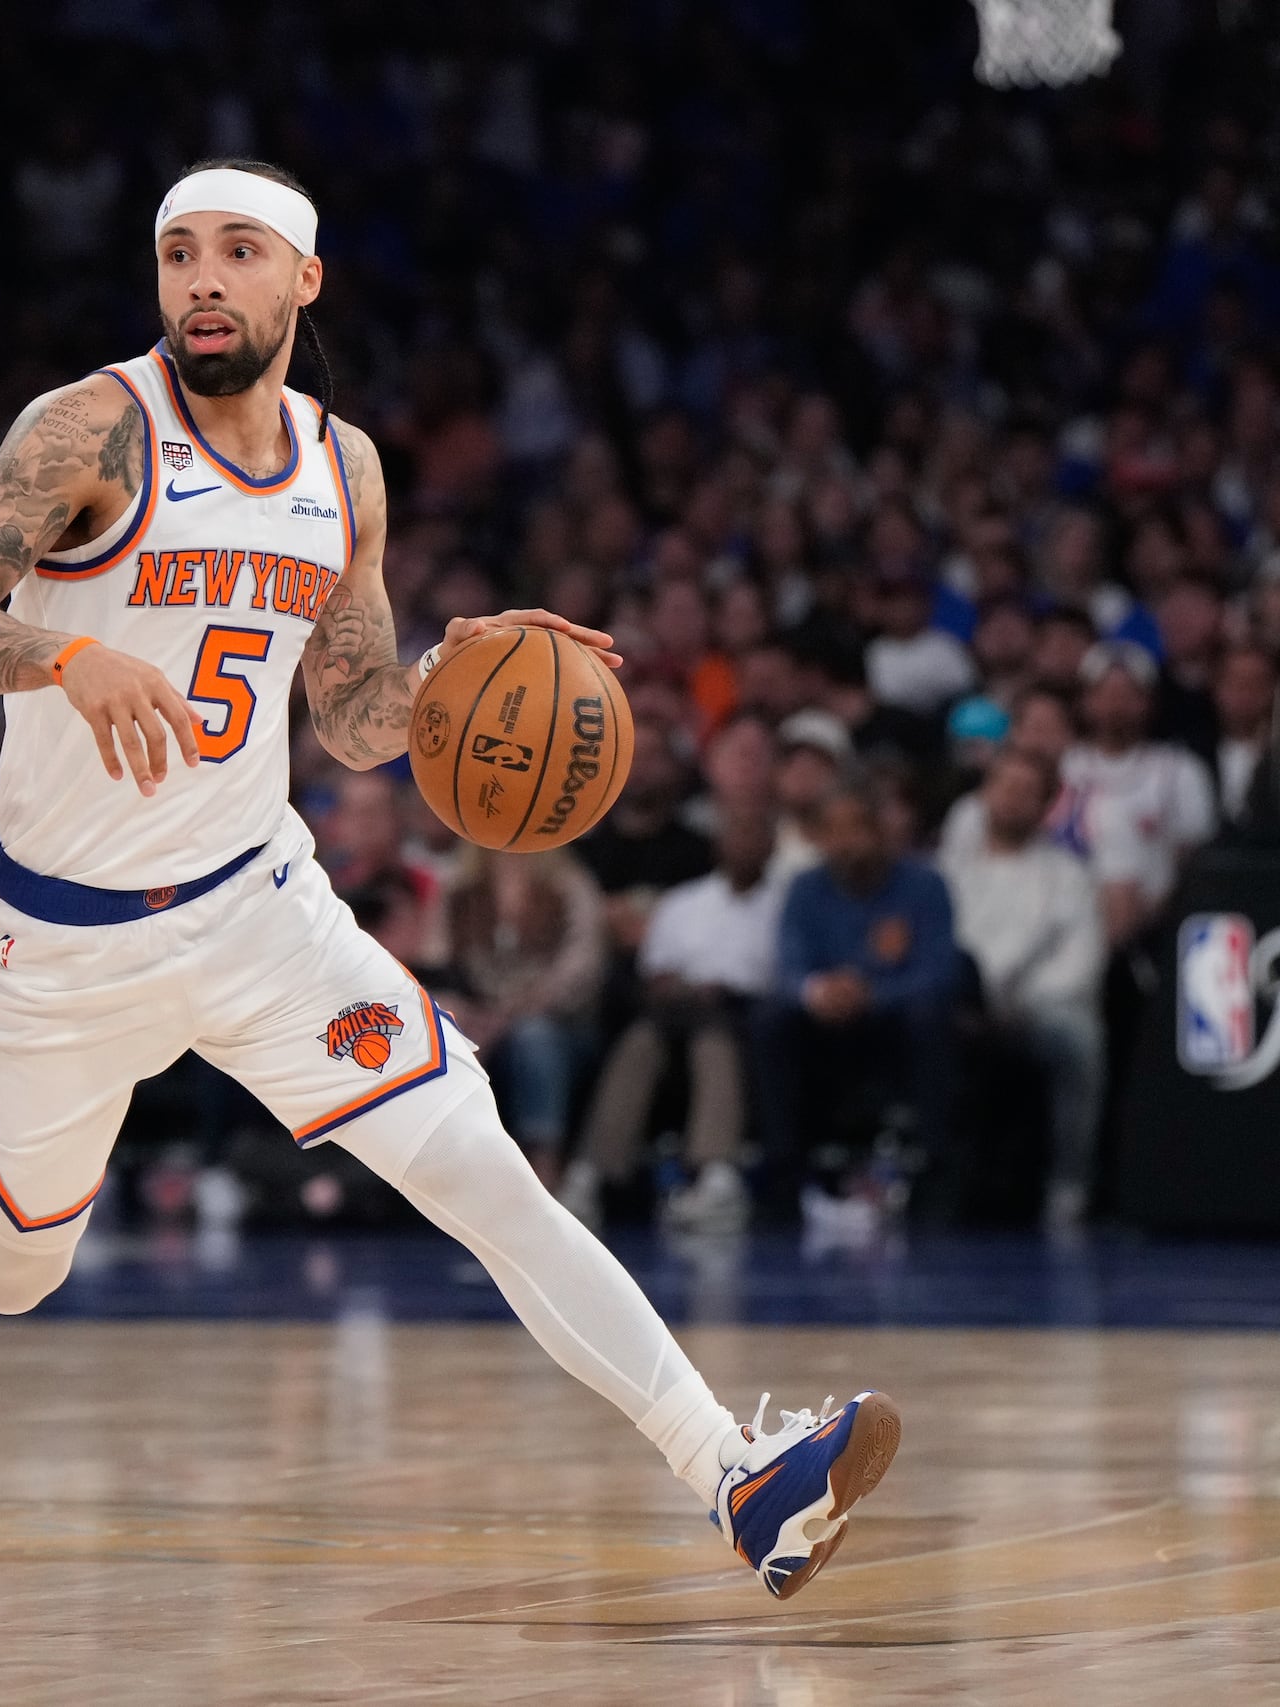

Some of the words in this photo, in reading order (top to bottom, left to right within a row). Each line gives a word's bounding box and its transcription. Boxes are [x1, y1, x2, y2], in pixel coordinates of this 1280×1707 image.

[163, 443, 191, 454] USA
[164, 455, 193, 467] 250
[291, 503, 311, 516] abu
[311, 505, 338, 520] dhabi
[125, 548, 245, 609] NEW
[249, 550, 339, 624] YORK
[187, 624, 275, 764] 5
[327, 1003, 405, 1058] KNICKS
